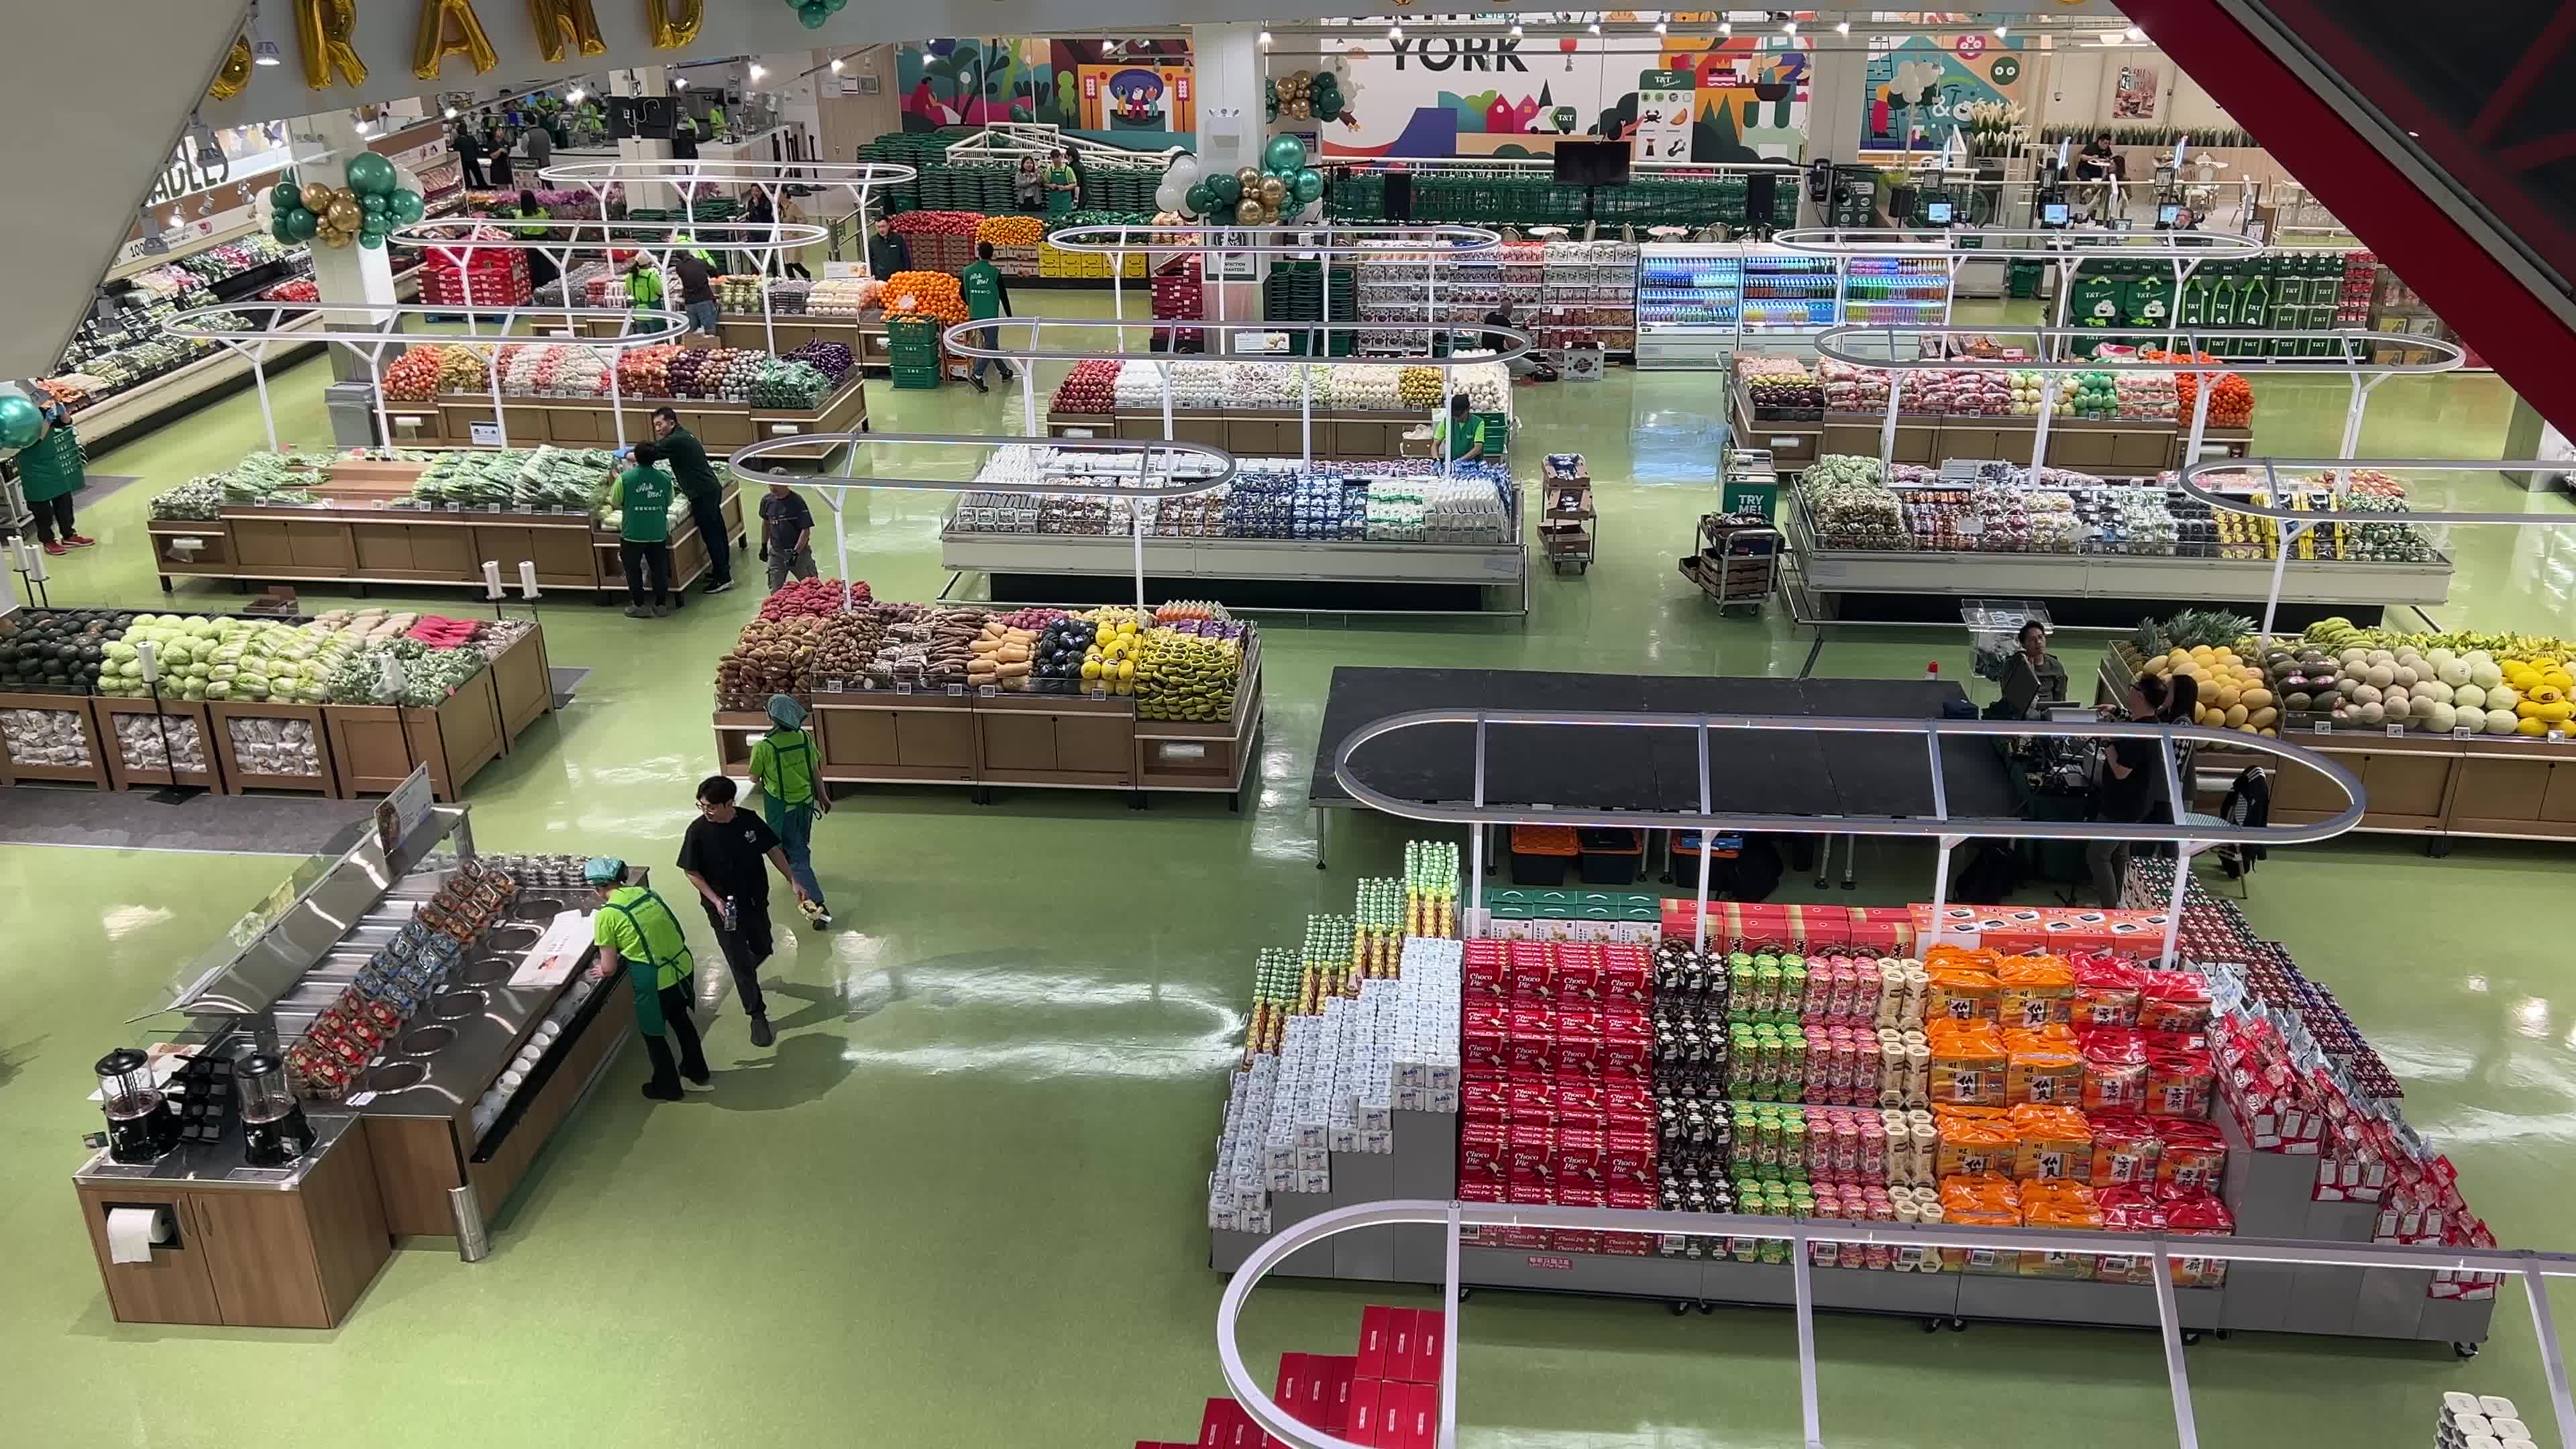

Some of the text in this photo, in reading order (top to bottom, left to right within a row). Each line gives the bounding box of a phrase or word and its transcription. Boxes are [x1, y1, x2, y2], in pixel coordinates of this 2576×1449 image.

[1389, 38, 1529, 72] YORK
[1739, 494, 1764, 505] TRY
[1739, 504, 1762, 515] ME!
[1517, 975, 1541, 983] Choco
[1611, 979, 1634, 987] Choco
[1611, 985, 1625, 994] Pie
[1515, 1046, 1538, 1055] Choco
[1562, 1050, 1586, 1058] Choco
[1610, 1052, 1633, 1060] Choco
[1465, 1150, 1490, 1159] Choco
[1515, 1152, 1538, 1161] Choco
[1515, 1159, 1529, 1167] Pie
[1563, 1156, 1587, 1164] Choco
[1613, 1159, 1637, 1167] Choco
[1564, 1163, 1577, 1171] Pie
[1613, 1165, 1627, 1173] Pie
